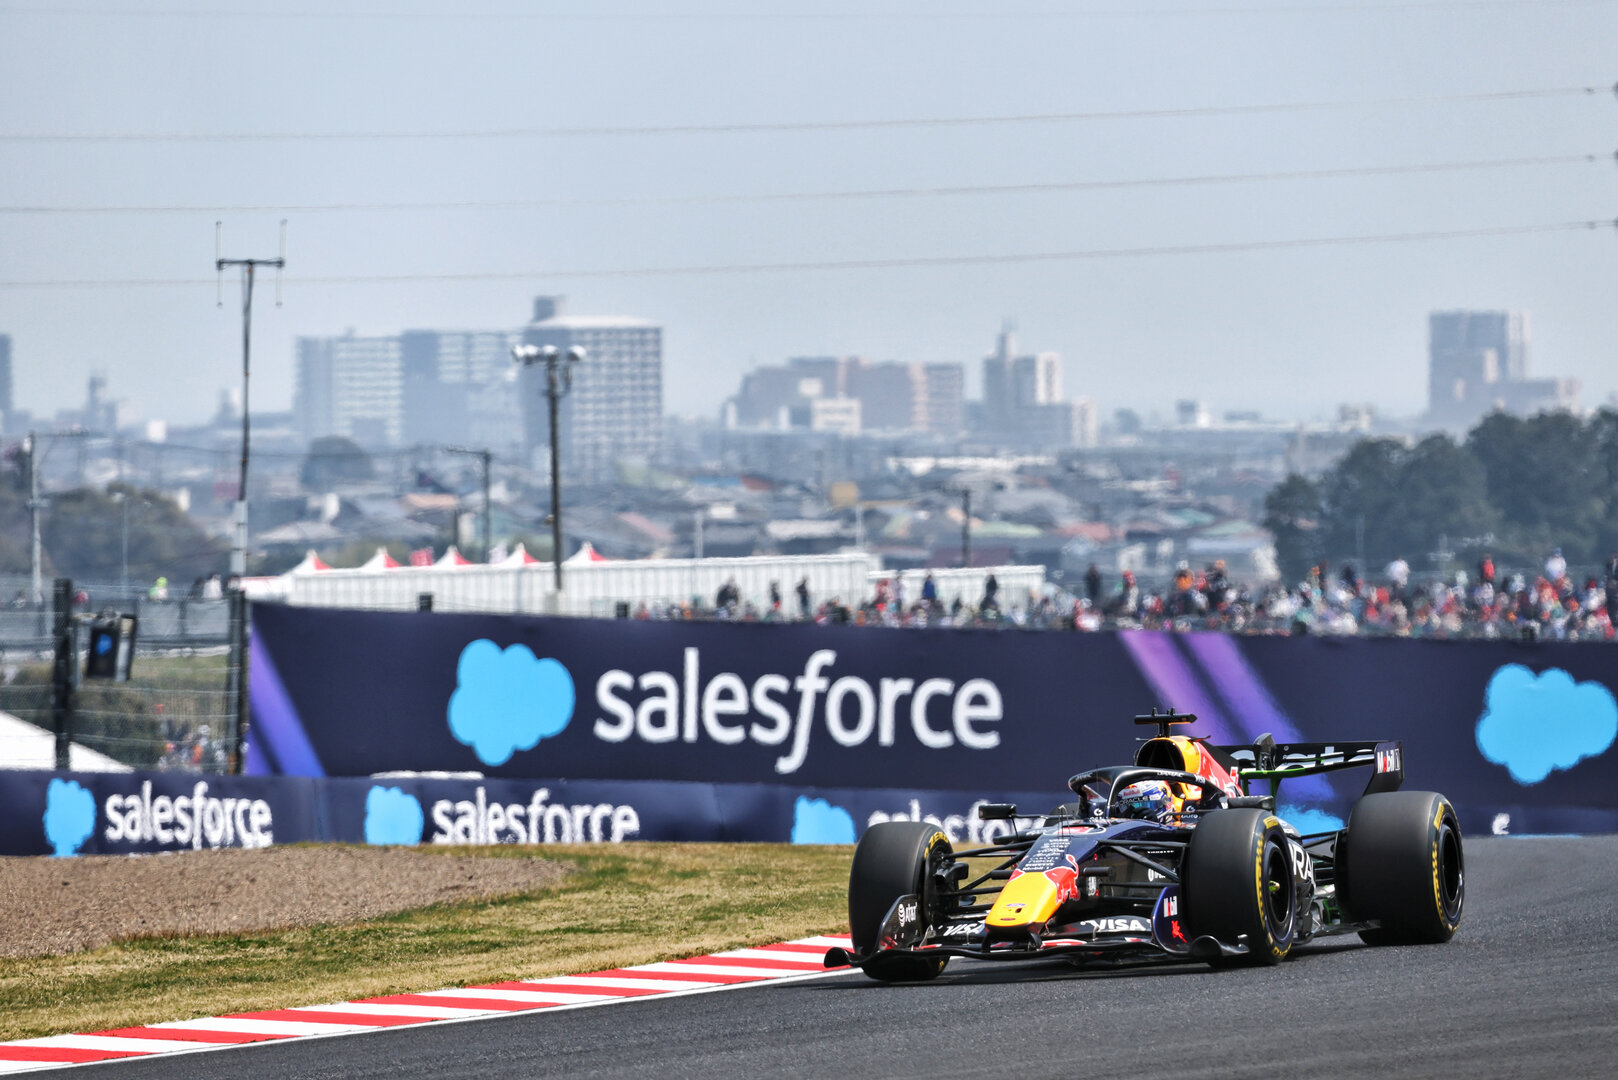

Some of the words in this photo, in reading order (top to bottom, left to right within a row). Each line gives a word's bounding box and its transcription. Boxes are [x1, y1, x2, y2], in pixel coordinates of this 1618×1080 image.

[594, 647, 1003, 774] salesforce
[1377, 750, 1394, 773] Mobil
[105, 780, 273, 850] salesforce
[1086, 919, 1147, 932] VISA
